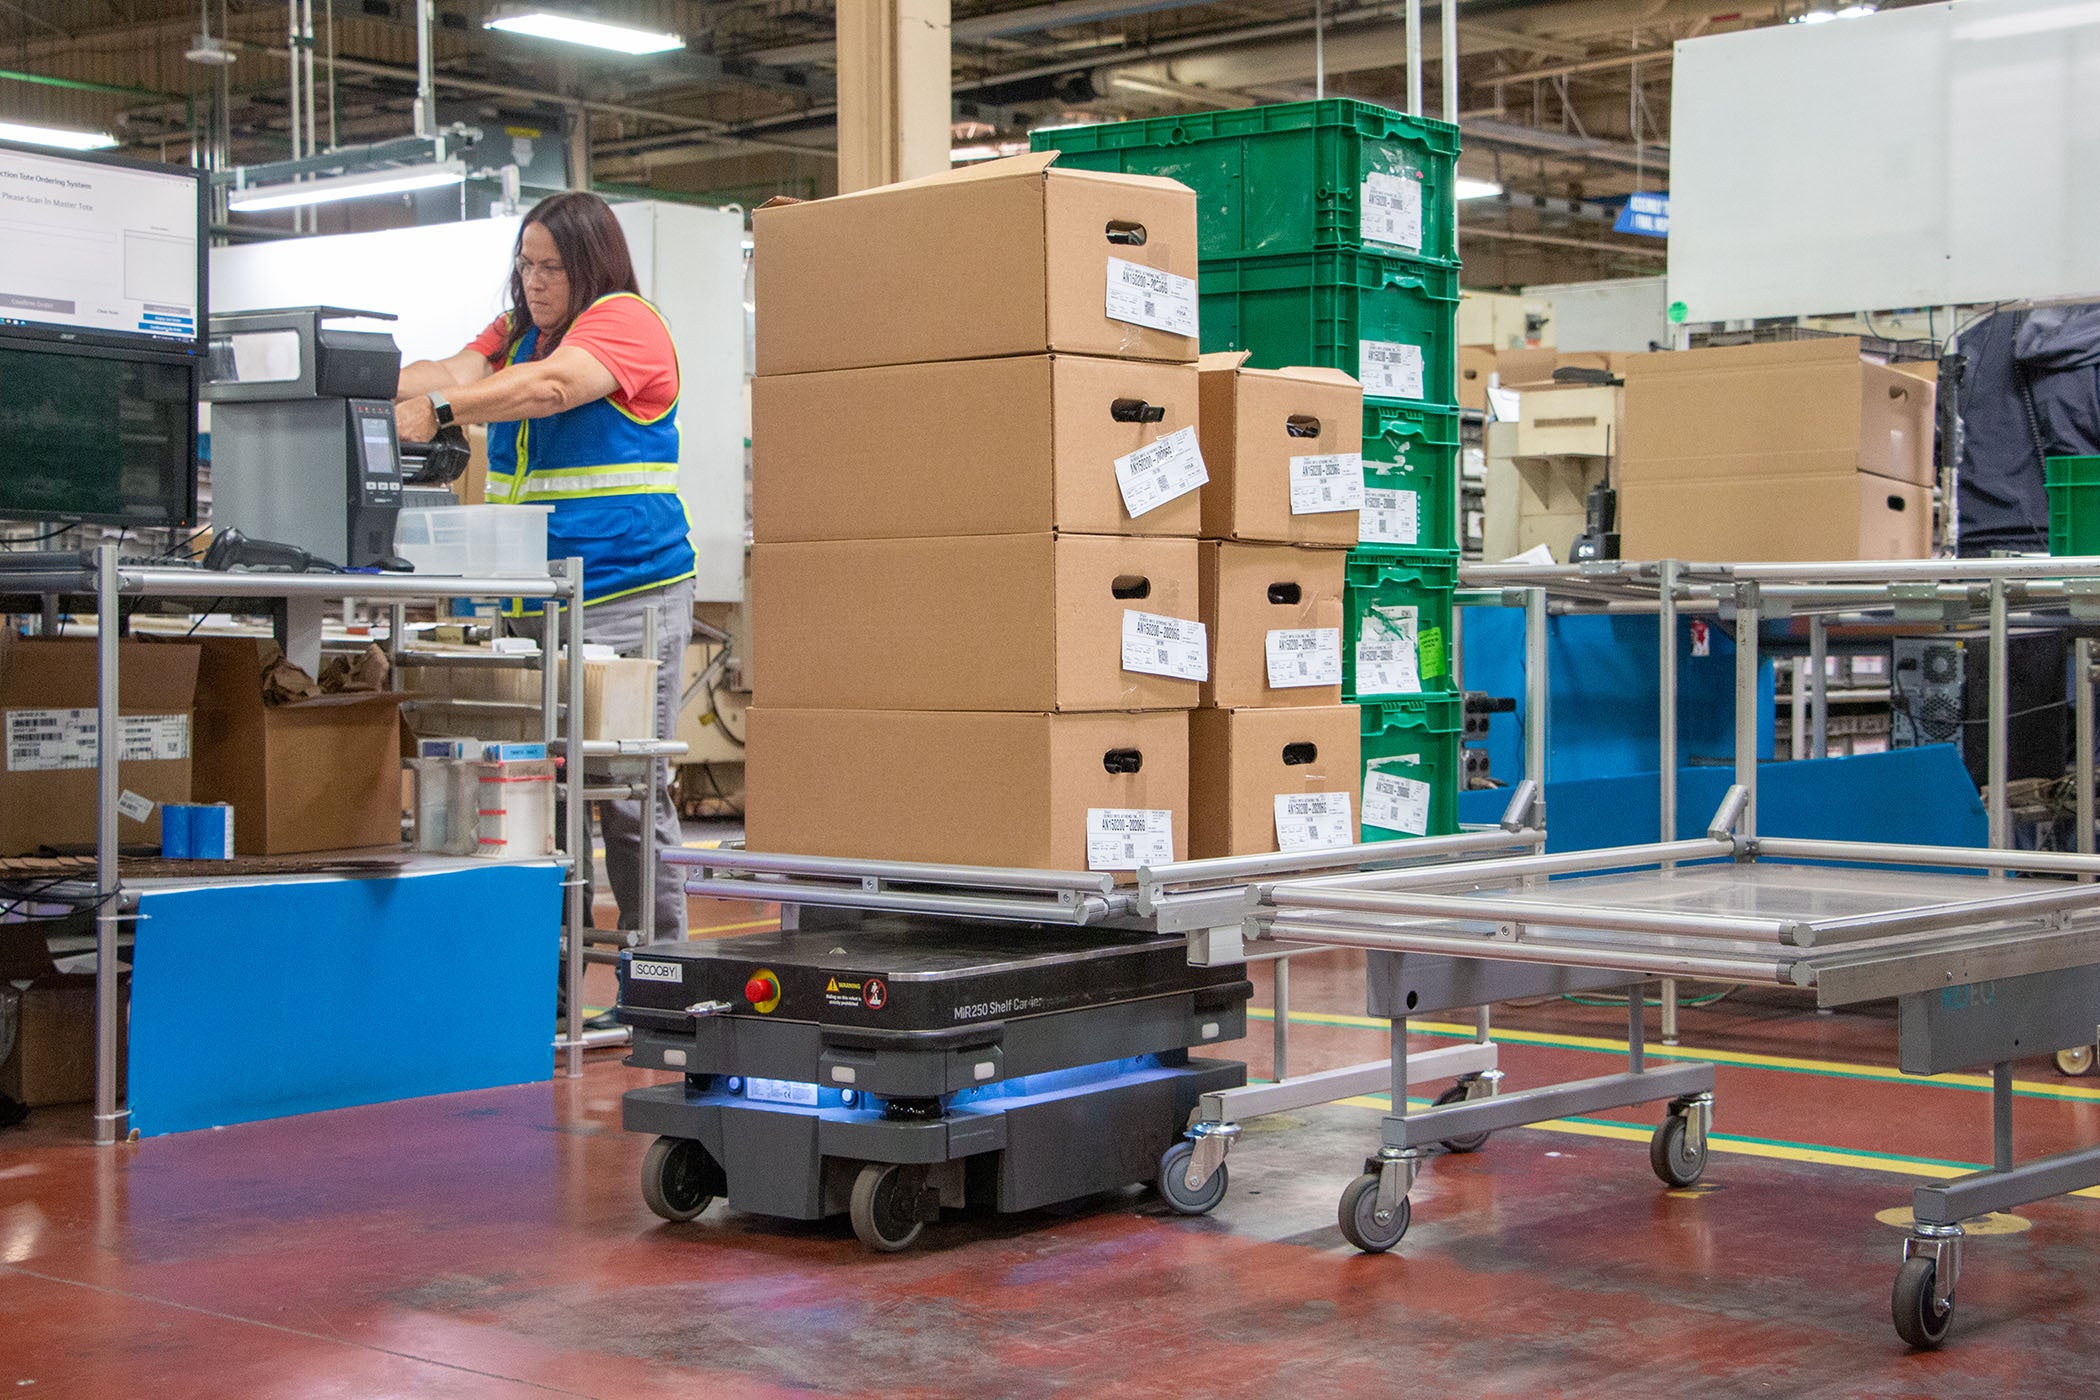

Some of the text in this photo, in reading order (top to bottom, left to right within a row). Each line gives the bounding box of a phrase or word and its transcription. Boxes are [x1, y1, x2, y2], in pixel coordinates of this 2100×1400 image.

[20, 172, 34, 181] Tote
[35, 175, 66, 187] Ordering
[66, 179, 92, 190] System
[1, 191, 25, 202] Please
[26, 194, 42, 204] Scan
[53, 199, 77, 209] Master
[78, 202, 94, 211] Tote
[636, 964, 675, 977] SCOOBY
[954, 1002, 988, 1020] MiR250
[989, 999, 1012, 1015] Shelf
